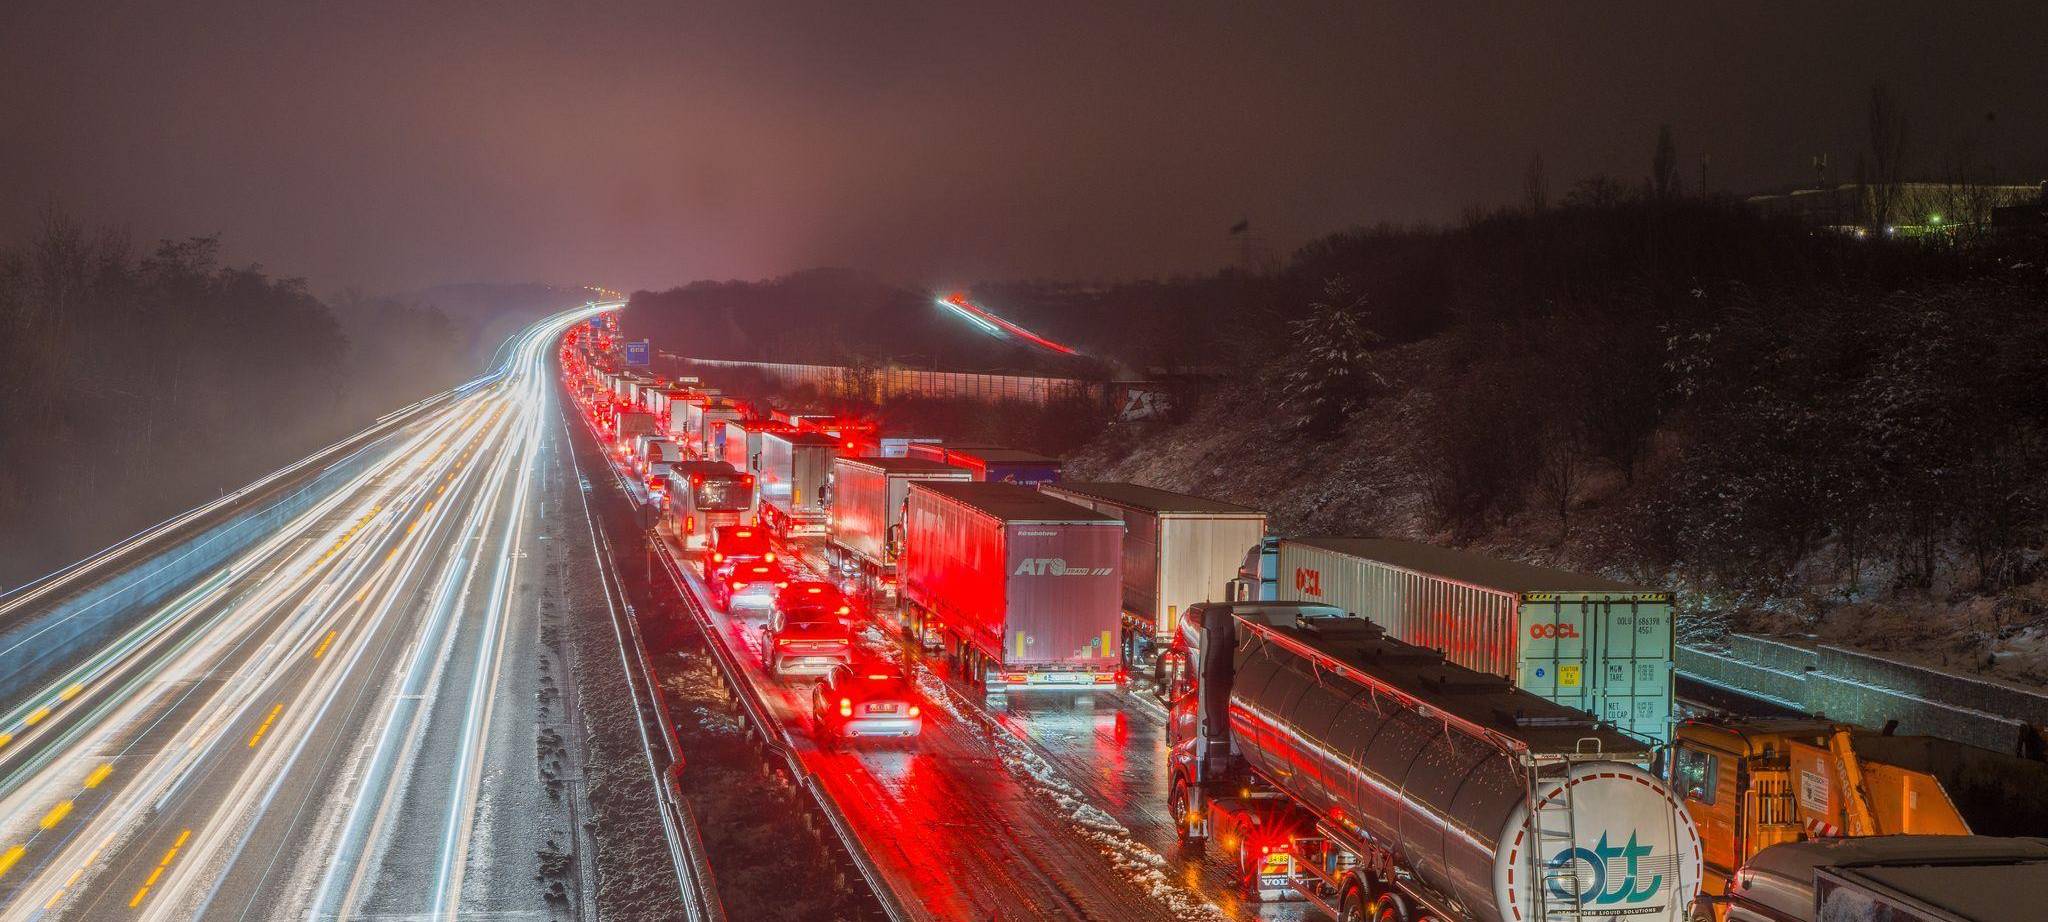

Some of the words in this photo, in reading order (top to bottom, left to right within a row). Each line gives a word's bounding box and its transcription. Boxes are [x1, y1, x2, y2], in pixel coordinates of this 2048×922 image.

[1295, 567, 1322, 597] OOCL
[1529, 623, 1580, 640] OOCL
[1623, 907, 1656, 915] SOLUTIONS
